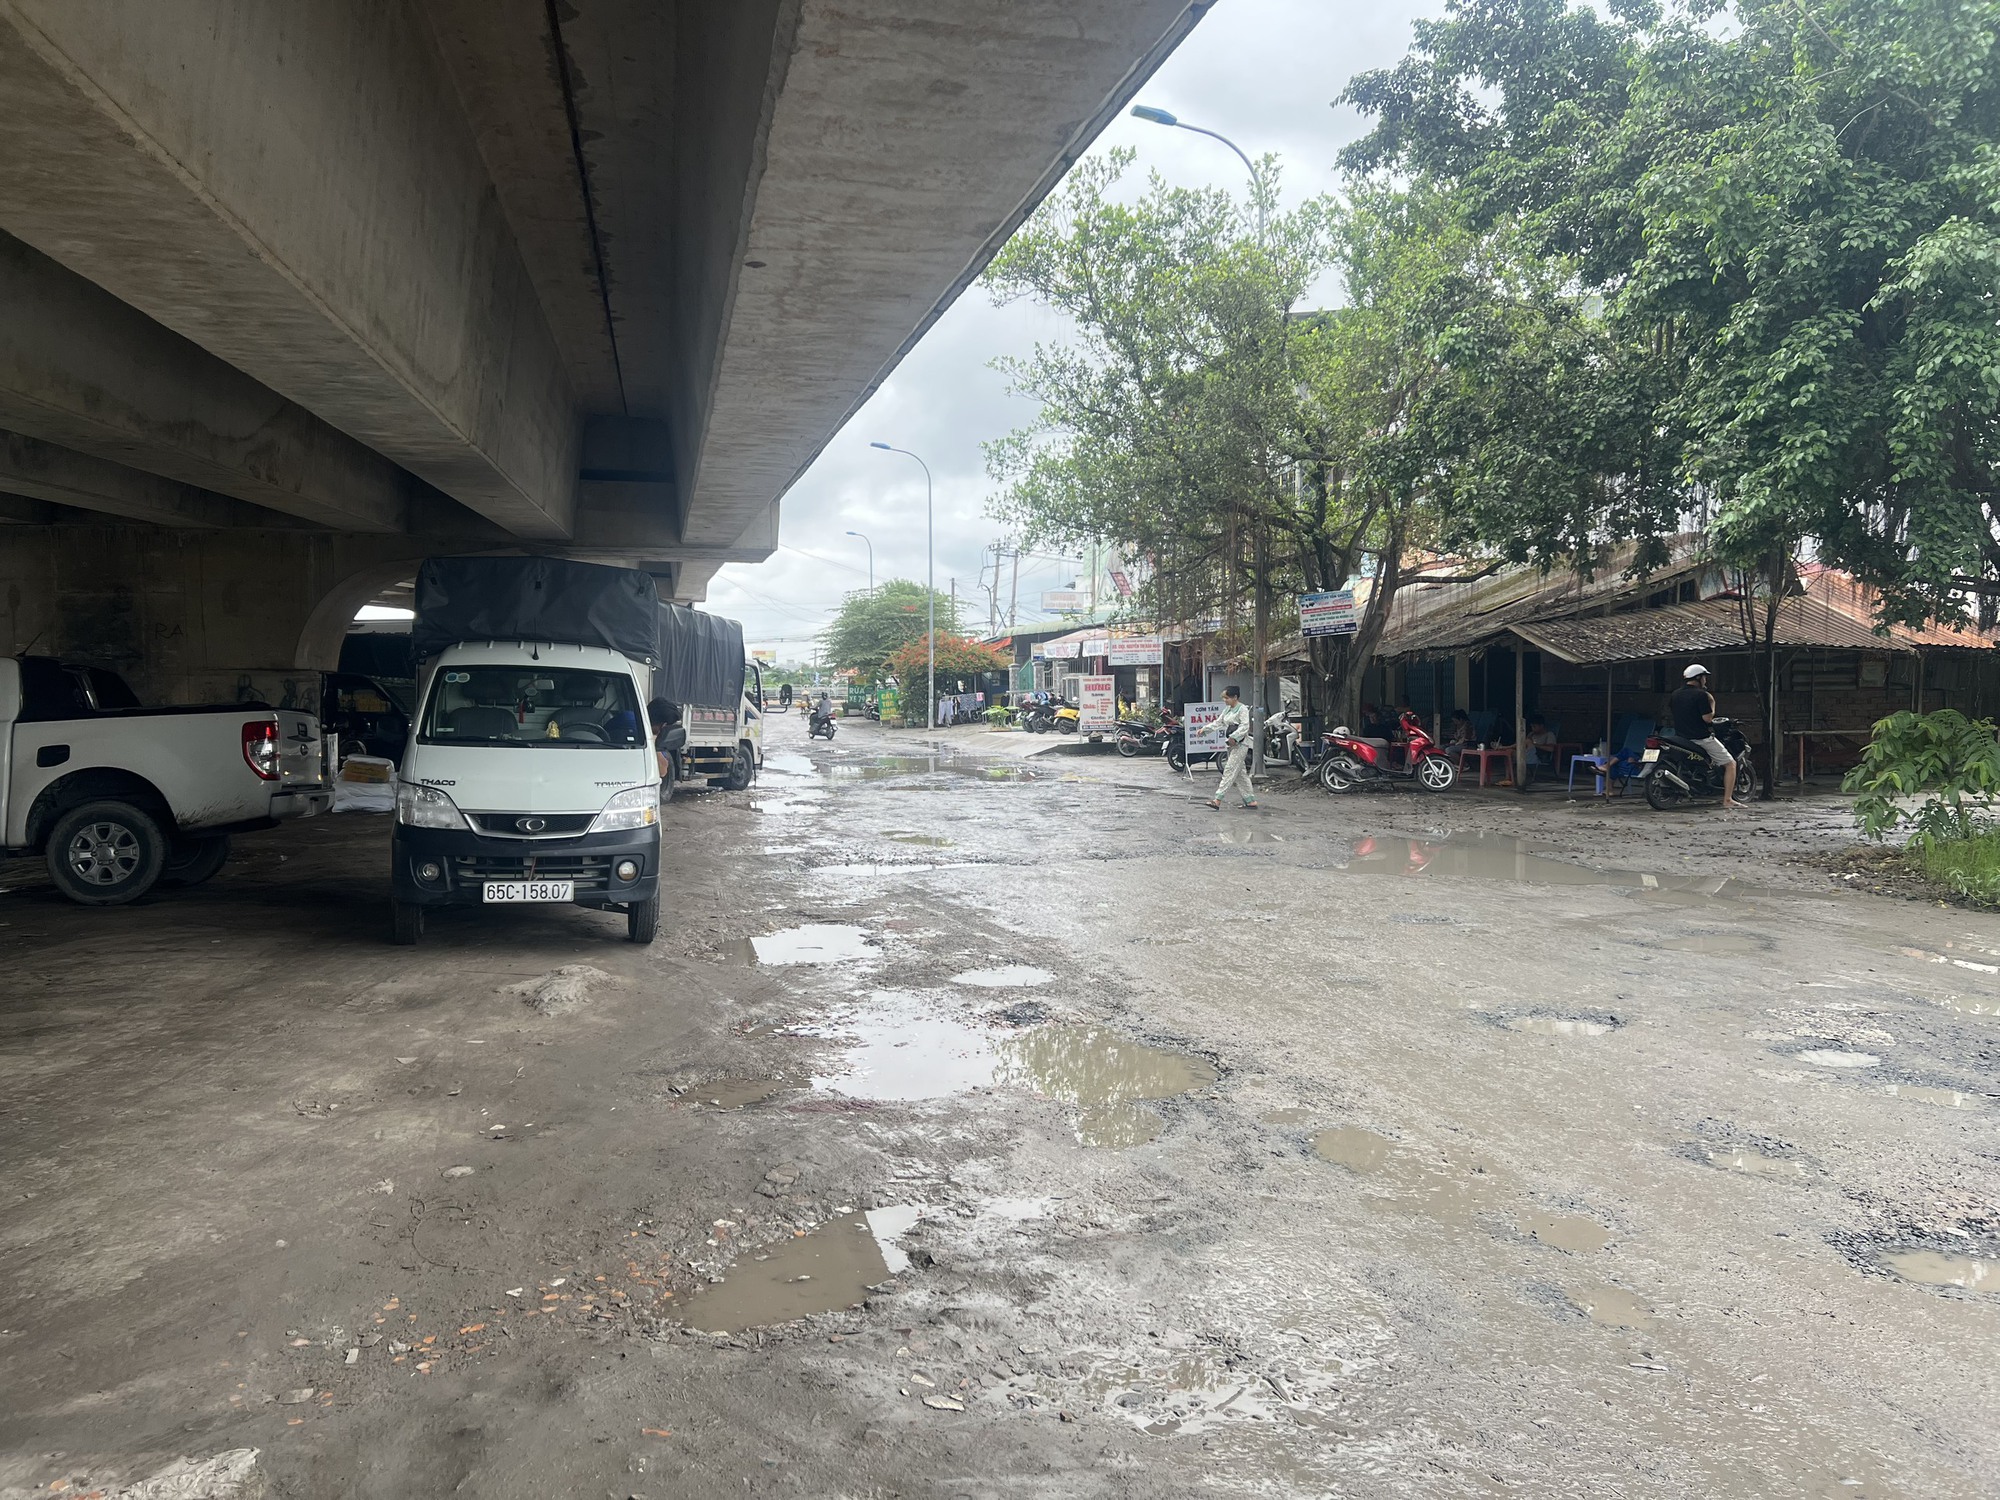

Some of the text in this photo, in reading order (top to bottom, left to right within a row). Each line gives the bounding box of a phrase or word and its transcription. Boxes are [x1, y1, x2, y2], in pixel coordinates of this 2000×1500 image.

[1205, 712, 1220, 722] NĂ
[420, 778, 456, 786] THACO
[486, 883, 570, 900] 65C-158.07
